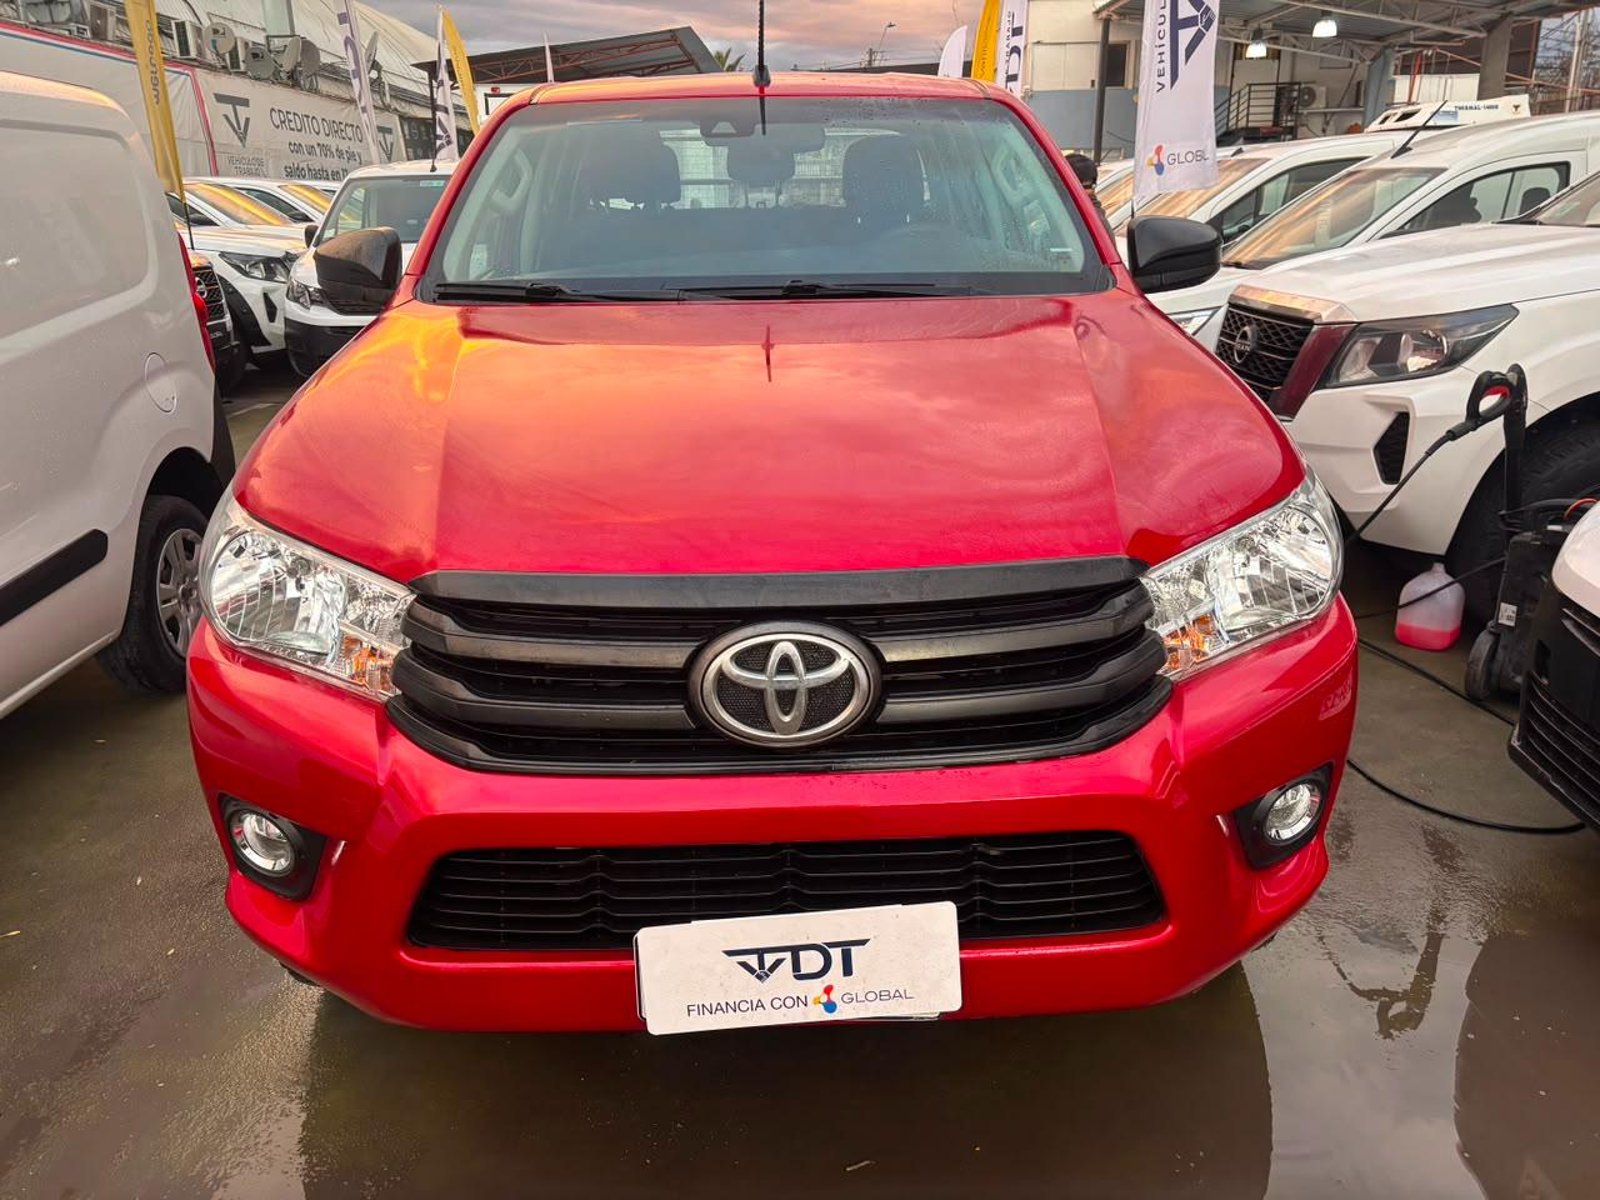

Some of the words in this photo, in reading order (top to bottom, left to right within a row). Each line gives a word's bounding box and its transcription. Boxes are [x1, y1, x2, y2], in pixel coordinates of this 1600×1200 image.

[270, 107, 320, 136] CREDITO
[321, 117, 364, 143] DIRECTO
[288, 141, 304, 155] con
[305, 143, 317, 157] un
[317, 143, 335, 159] 70%
[335, 146, 345, 160] de
[356, 151, 362, 165] y
[284, 162, 306, 178] saldo
[306, 163, 330, 181] hasta
[330, 169, 341, 182] en
[687, 1000, 766, 1018] FINANCIA
[770, 995, 808, 1011] CON
[841, 988, 914, 1004] GLOBAL
